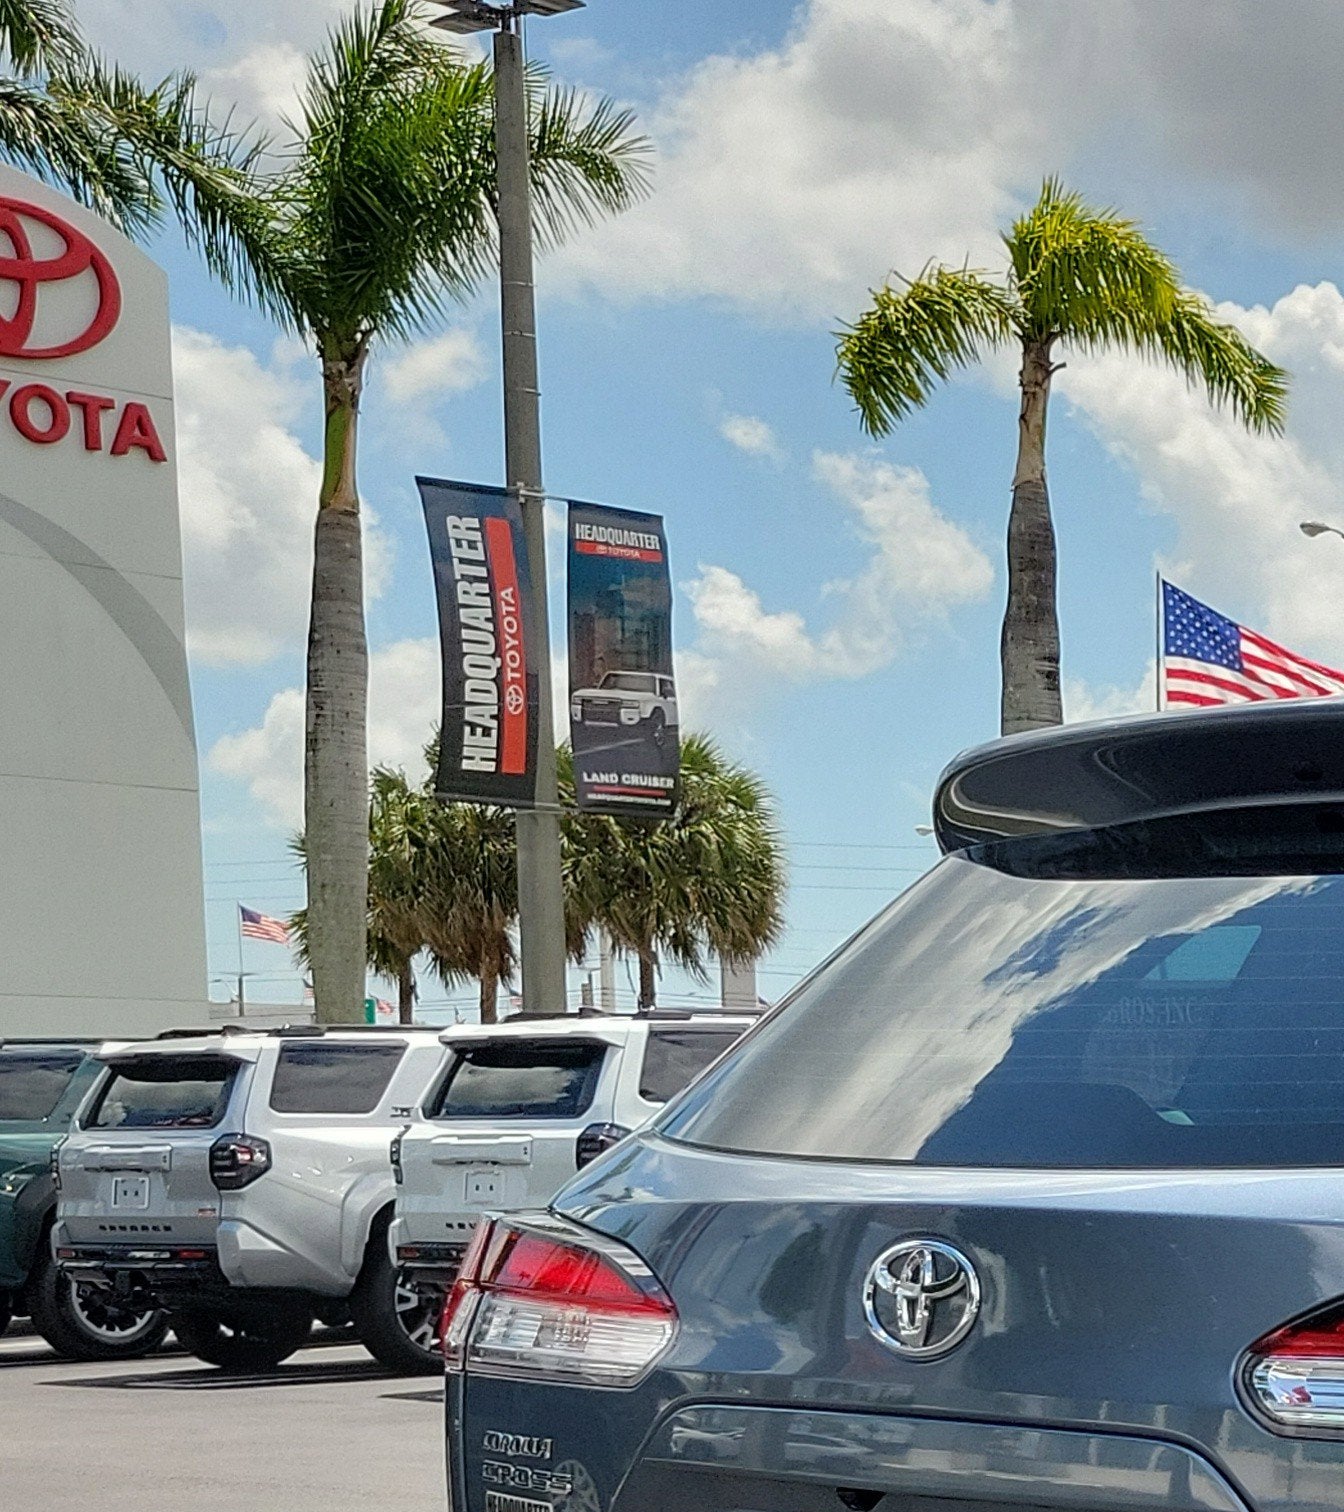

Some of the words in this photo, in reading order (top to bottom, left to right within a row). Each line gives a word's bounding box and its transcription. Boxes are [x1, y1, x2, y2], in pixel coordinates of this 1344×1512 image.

[0, 380, 167, 462] OTA
[575, 523, 660, 550] HEADQUARTER
[608, 546, 640, 558] TOYOTA
[446, 515, 501, 773] HEADQUARTER
[499, 587, 522, 682] TOYOTA
[582, 771, 618, 784] LAND
[621, 773, 675, 788] CRUISER
[482, 1459, 572, 1494] CROSS
